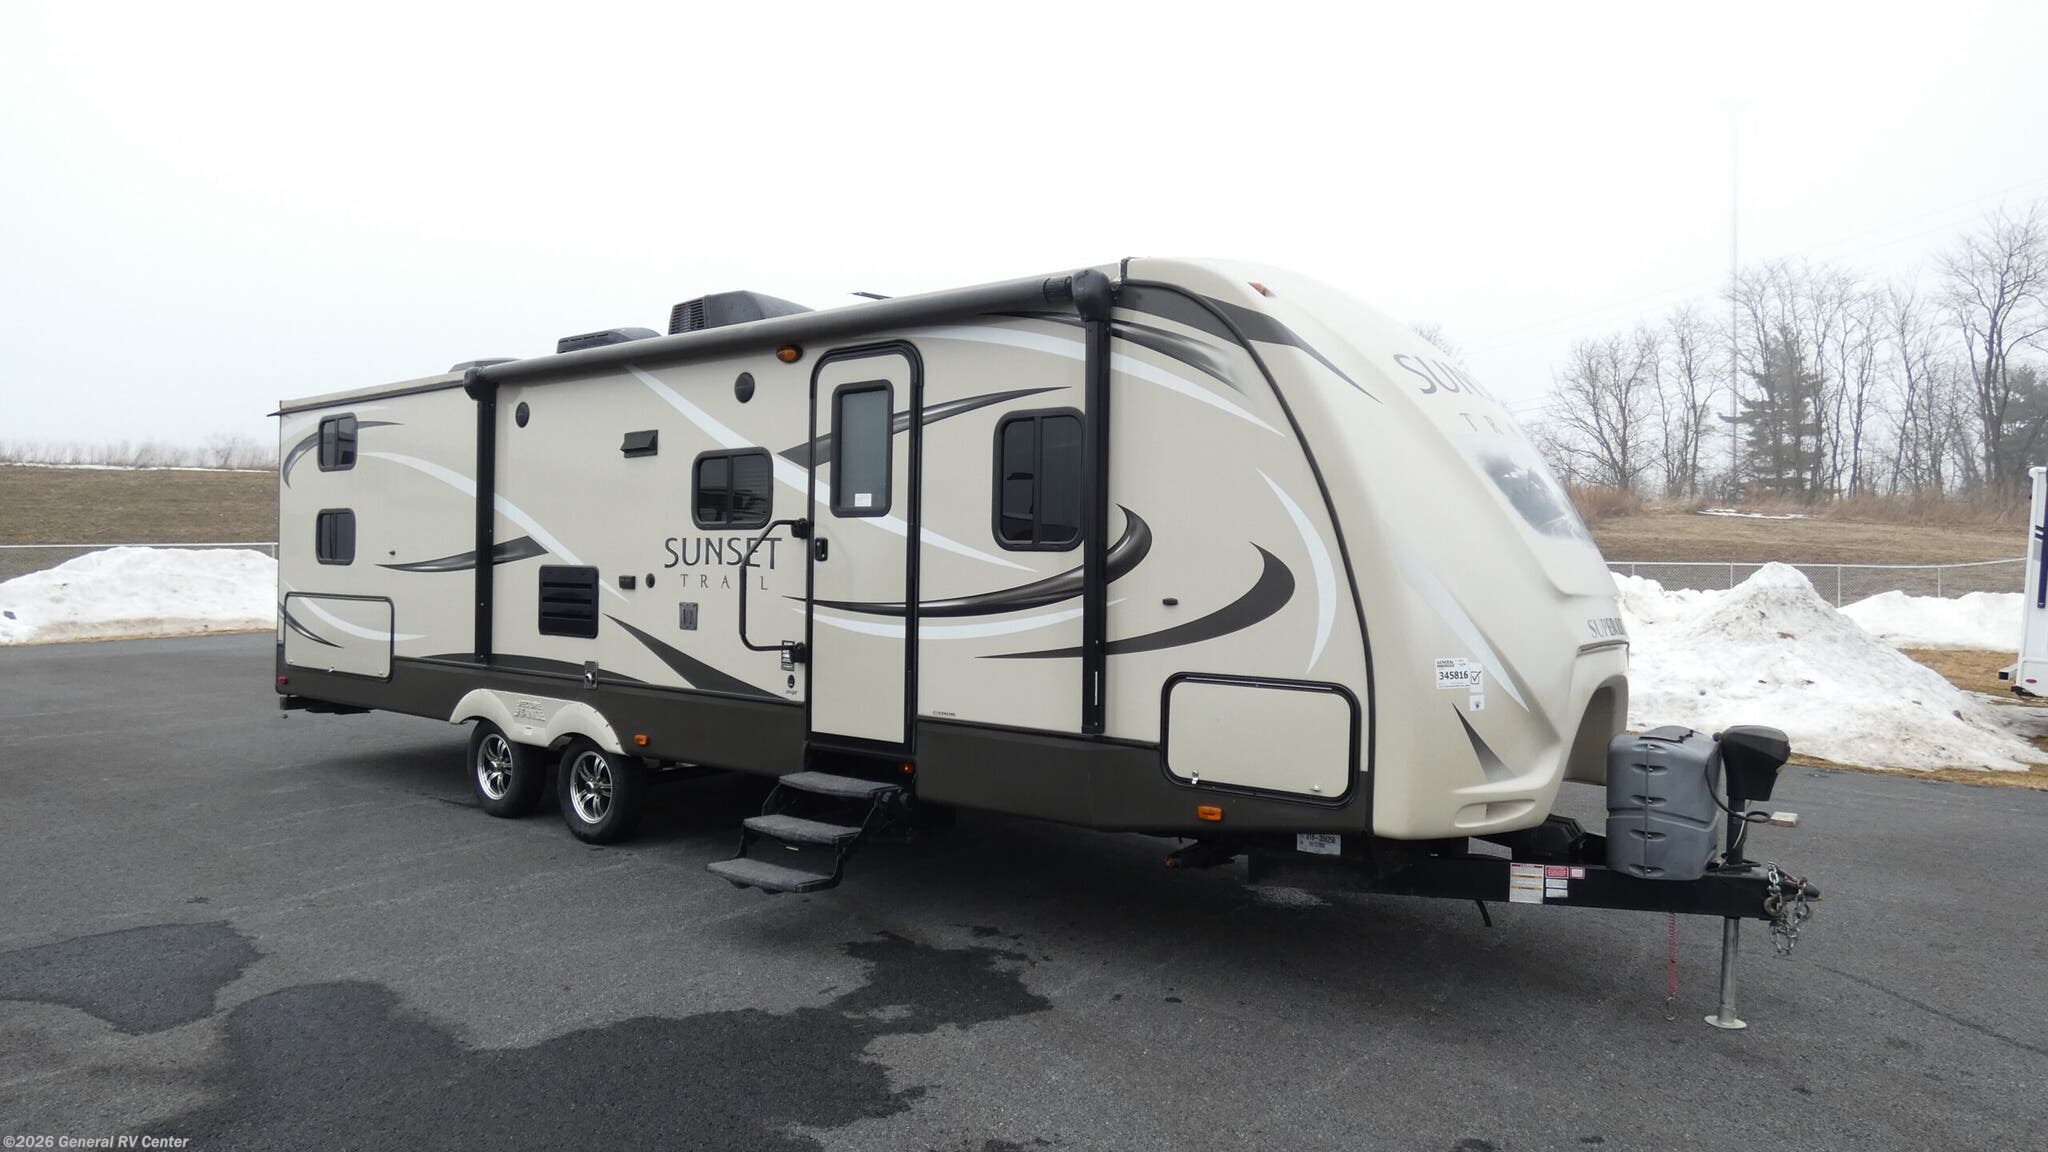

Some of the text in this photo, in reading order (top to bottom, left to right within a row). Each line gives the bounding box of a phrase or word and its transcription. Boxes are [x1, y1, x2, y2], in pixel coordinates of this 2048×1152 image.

[664, 537, 782, 569] SUNSET
[680, 573, 768, 590] TRAL
[1439, 670, 1469, 680] 345816
